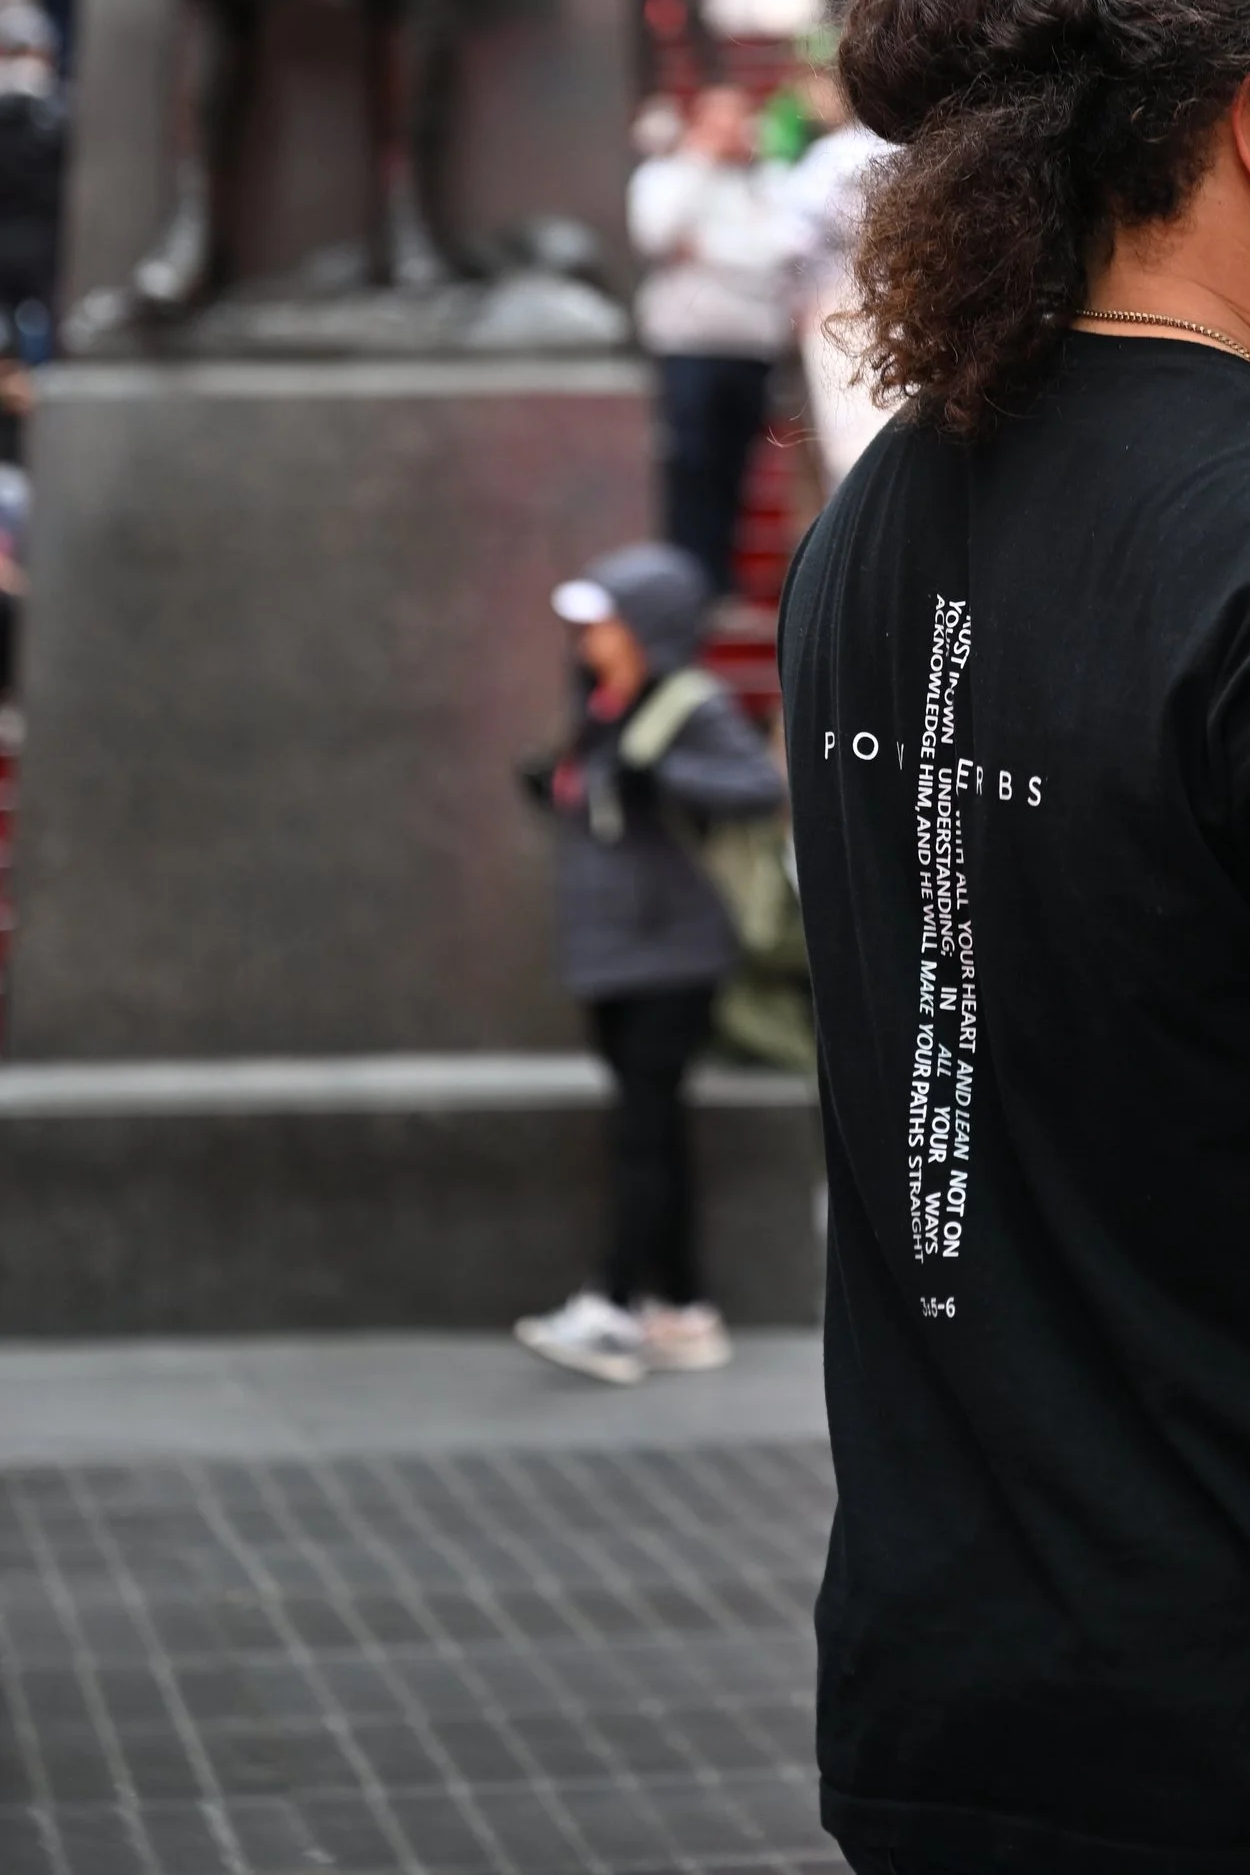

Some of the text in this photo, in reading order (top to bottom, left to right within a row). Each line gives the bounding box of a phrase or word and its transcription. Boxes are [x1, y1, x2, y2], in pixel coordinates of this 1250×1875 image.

[935, 767, 956, 957] UNDERSTANDING;
[955, 872, 969, 910] ALL
[907, 593, 946, 1265] ACKNOWLEDGE HIM, AND HE WILL MAKE YOUR PATHS STRAIGHT
[957, 920, 976, 980] YOUR
[939, 986, 958, 1012] IN
[958, 983, 977, 1055] HEART
[937, 1043, 952, 1078] ALL
[954, 1059, 974, 1107] AND
[927, 1106, 951, 1164] YOUR
[952, 1108, 971, 1161] LEAN
[946, 1169, 968, 1218] NOT
[925, 1192, 941, 1255] WAYS
[942, 1220, 962, 1258] ON
